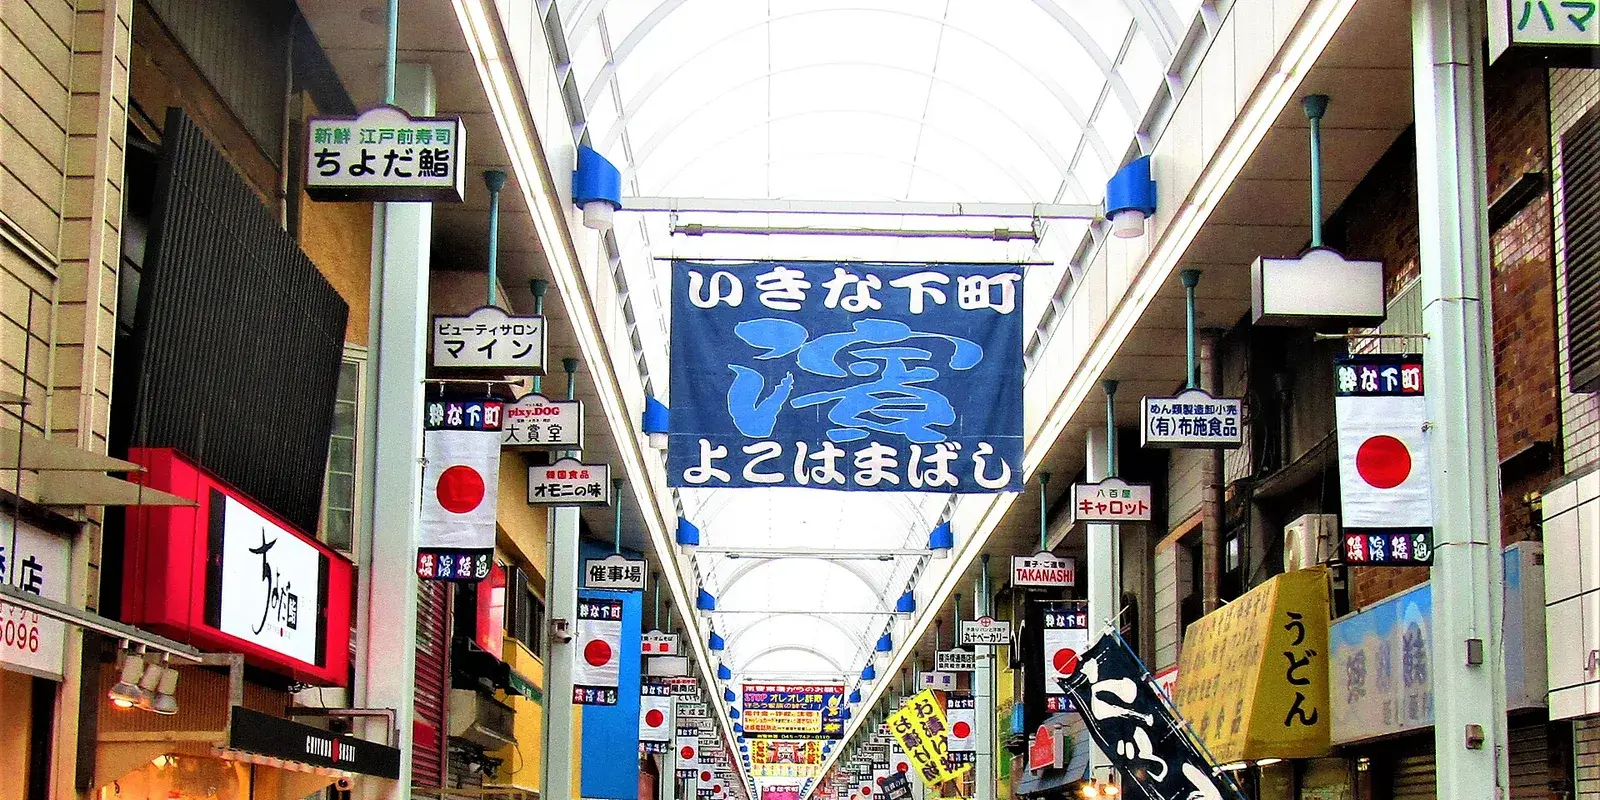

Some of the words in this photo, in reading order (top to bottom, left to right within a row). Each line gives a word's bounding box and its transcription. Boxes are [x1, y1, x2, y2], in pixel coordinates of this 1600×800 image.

[1517, 1, 1595, 32] ハマ
[315, 127, 351, 144] 新鮮
[359, 128, 450, 145] 江戸前寿司
[314, 148, 449, 177] ちよだ鮨
[687, 266, 1021, 315] いきな下町
[439, 324, 537, 337] ビューティサロン
[443, 339, 532, 359] マイン
[508, 407, 560, 418] pixy.DOG
[1150, 404, 1238, 415] めん類製造卸小売
[1150, 417, 1237, 436] (有)布施食品
[683, 438, 1012, 489] よこはまばし
[535, 483, 602, 498] オモニの味
[1097, 489, 1131, 498] 八百屋
[1079, 499, 1149, 516] キャロット
[590, 565, 642, 582] 催事場
[1016, 569, 1073, 582] TAKANASHI
[1284, 611, 1318, 728] うどん
